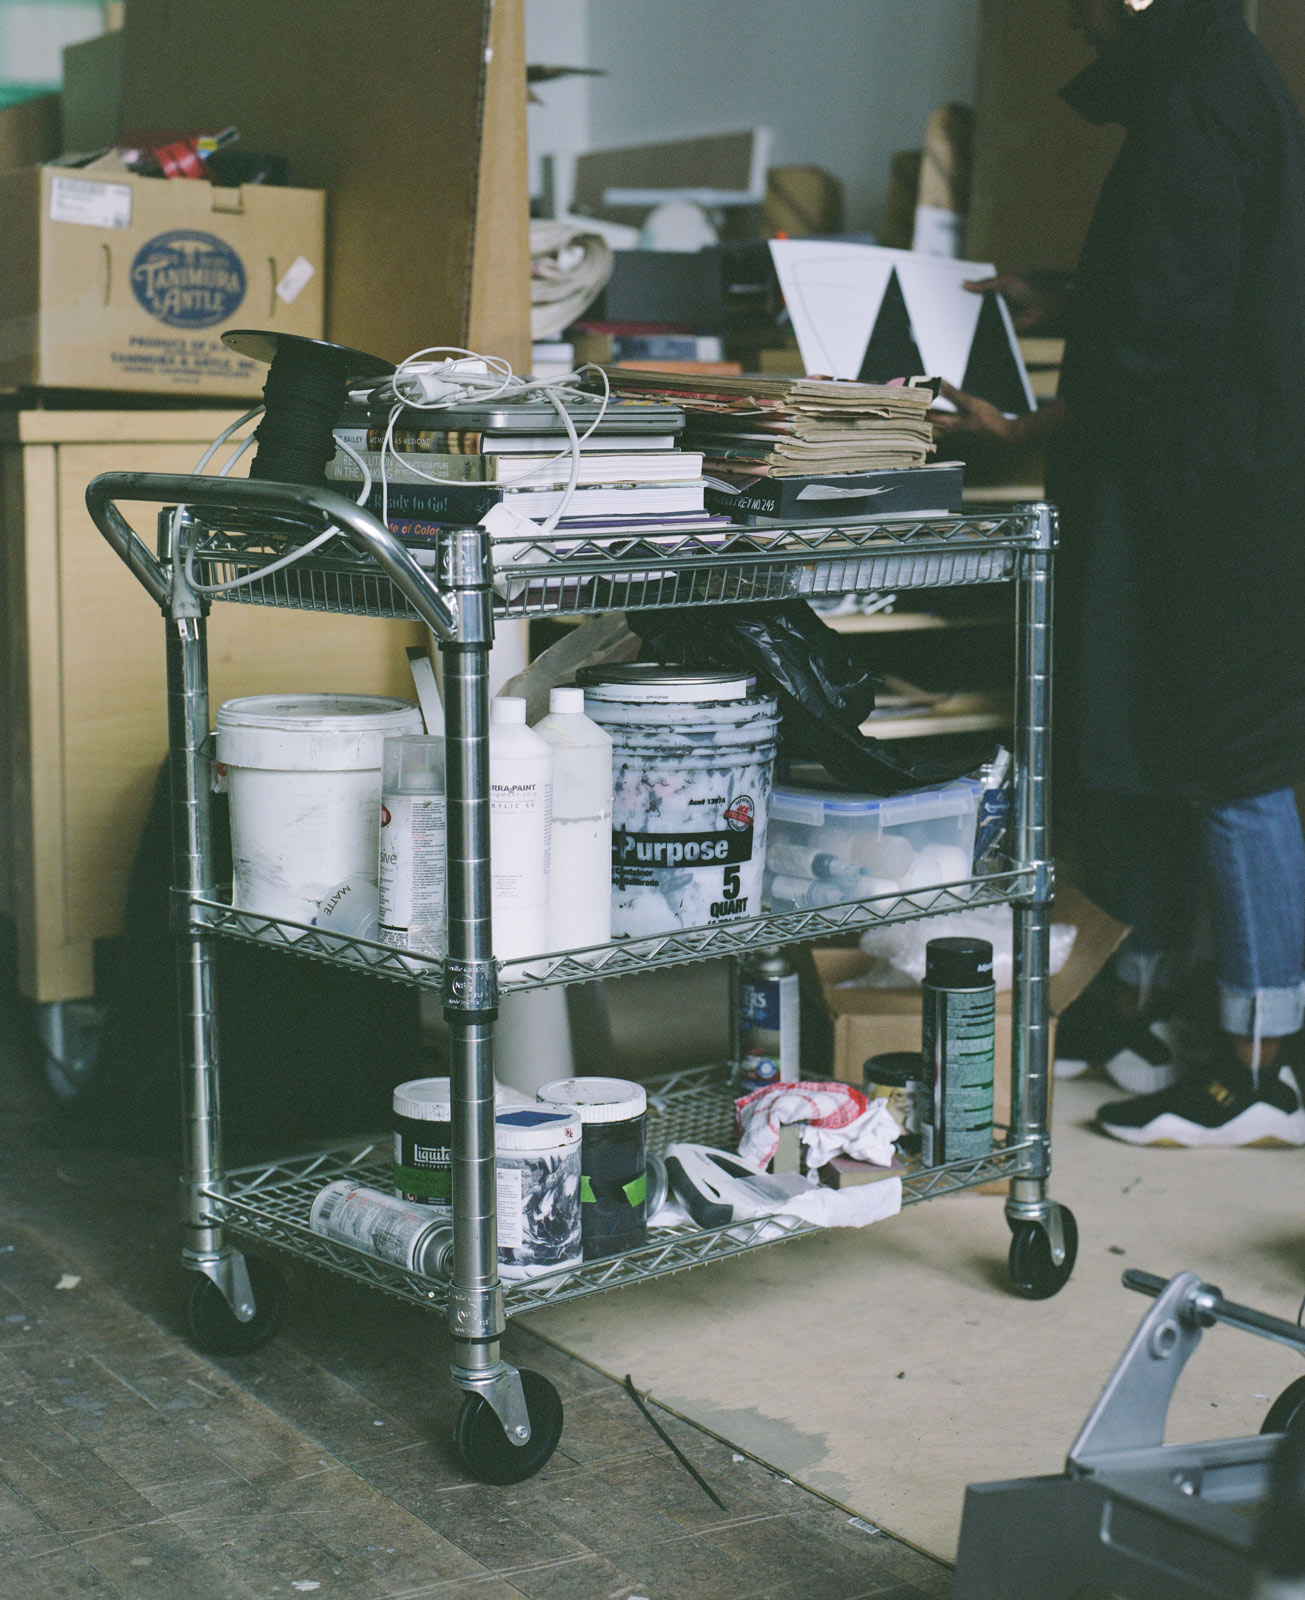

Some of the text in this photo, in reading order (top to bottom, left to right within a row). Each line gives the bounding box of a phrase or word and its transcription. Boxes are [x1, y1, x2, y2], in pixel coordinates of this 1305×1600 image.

[403, 438, 431, 446] MEDICINE
[343, 455, 393, 467] RELUTION
[334, 467, 344, 478] IN
[344, 467, 360, 478] THE
[374, 494, 409, 513] Rady
[414, 496, 424, 511] to
[428, 497, 448, 513] Go!
[401, 523, 411, 534] of
[414, 524, 441, 536] Color
[491, 784, 509, 792] RRA
[615, 867, 654, 877] Cntainer
[722, 865, 741, 900] 5
[323, 885, 352, 917] MATTE
[710, 897, 748, 919] QUART
[414, 1143, 453, 1164] Liquite
